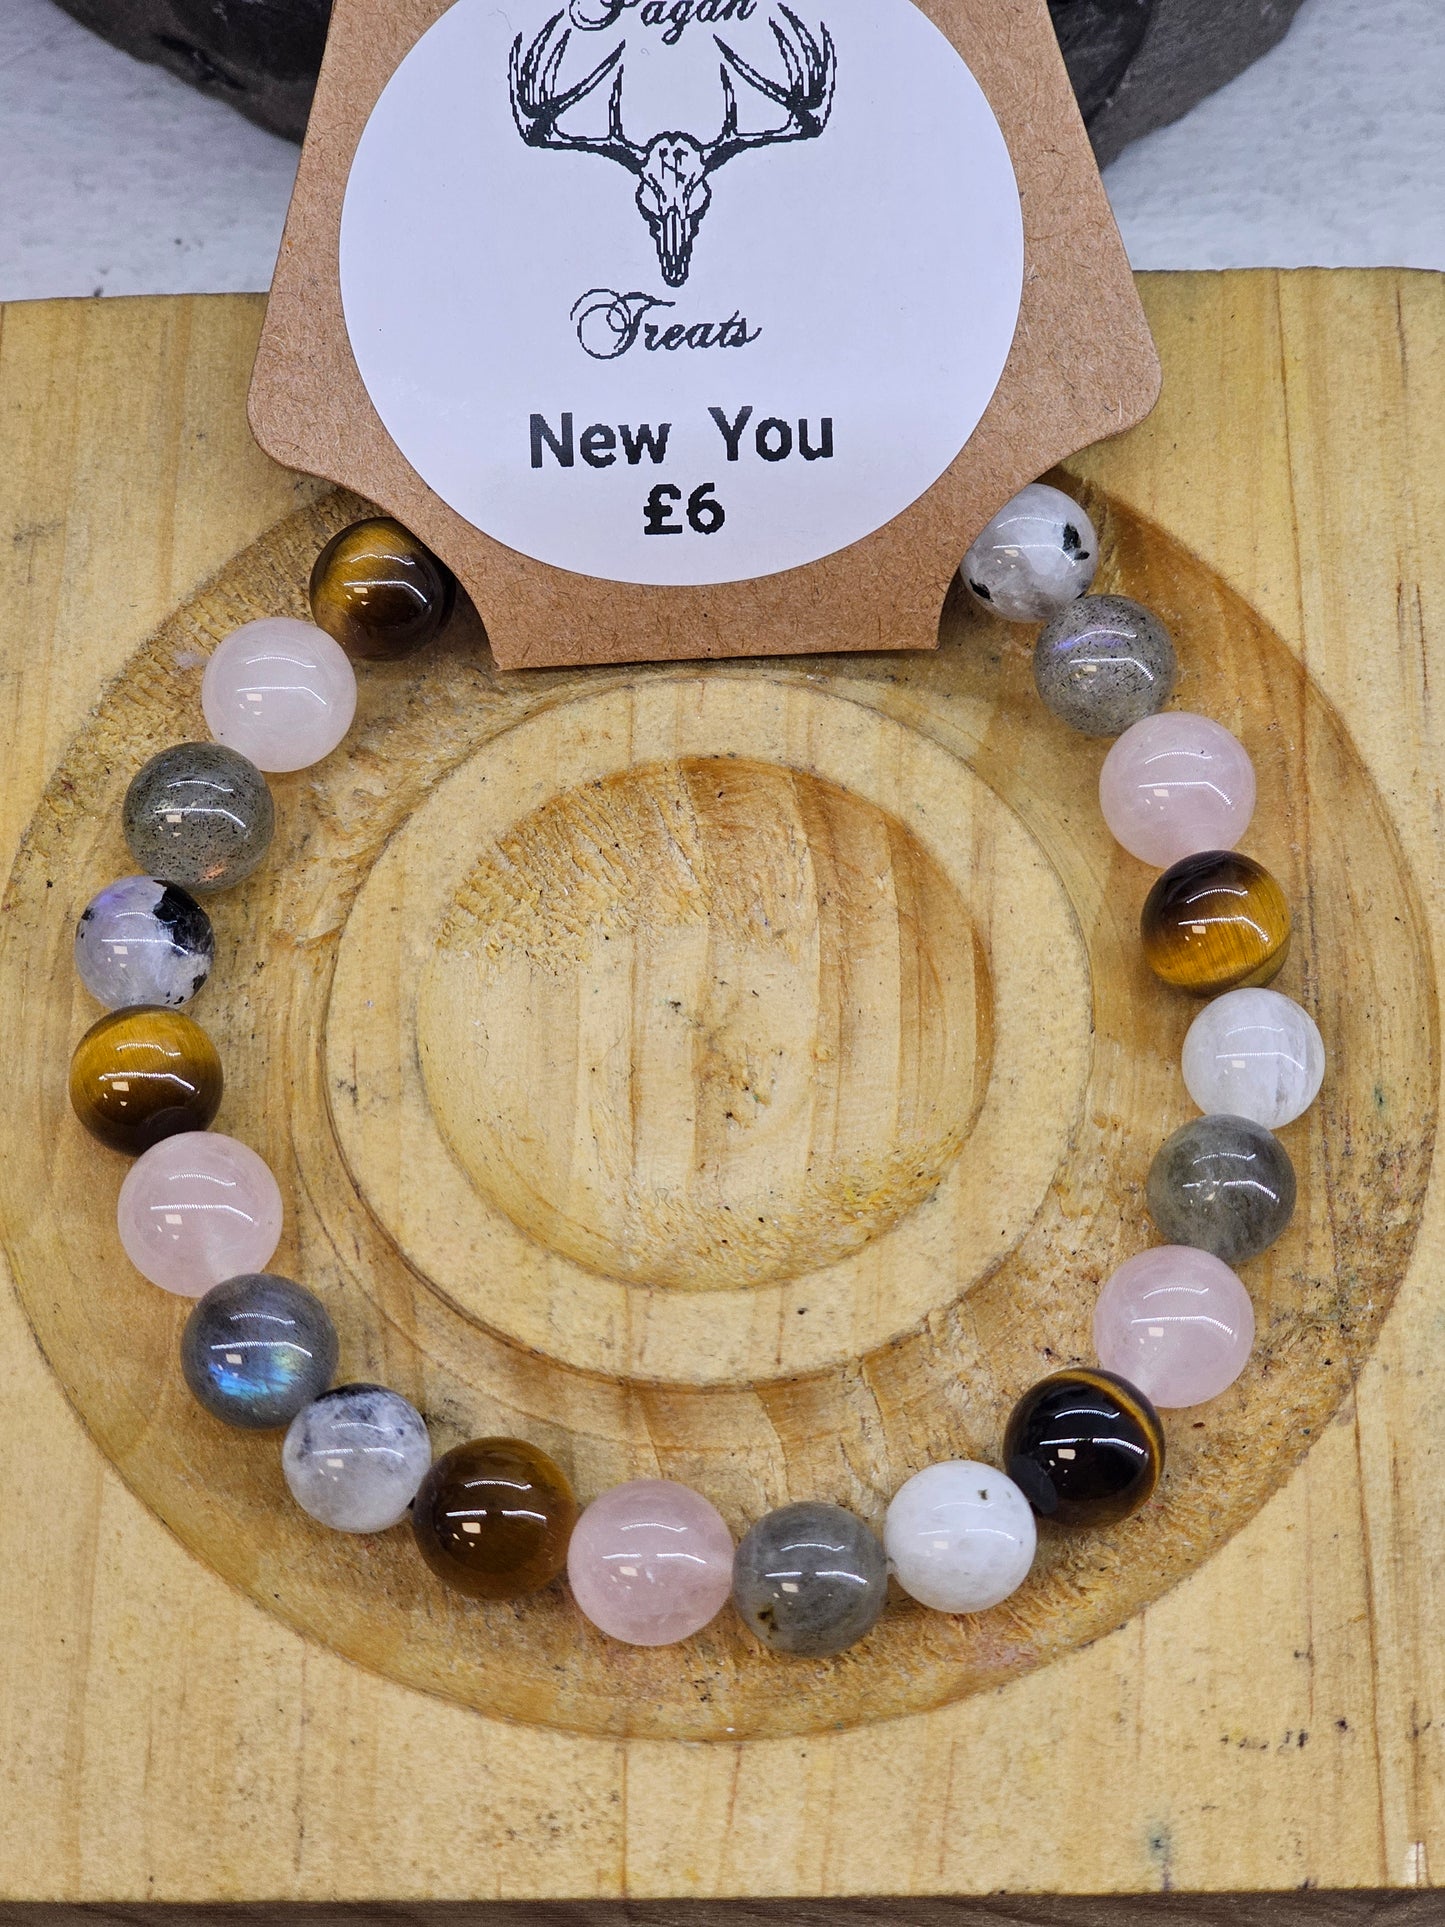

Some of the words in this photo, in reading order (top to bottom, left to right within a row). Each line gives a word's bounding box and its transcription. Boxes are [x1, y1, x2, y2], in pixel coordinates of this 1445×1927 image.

[569, 287, 763, 360] Treats
[529, 412, 673, 469] New
[707, 405, 834, 463] You
[643, 482, 726, 536] £6
